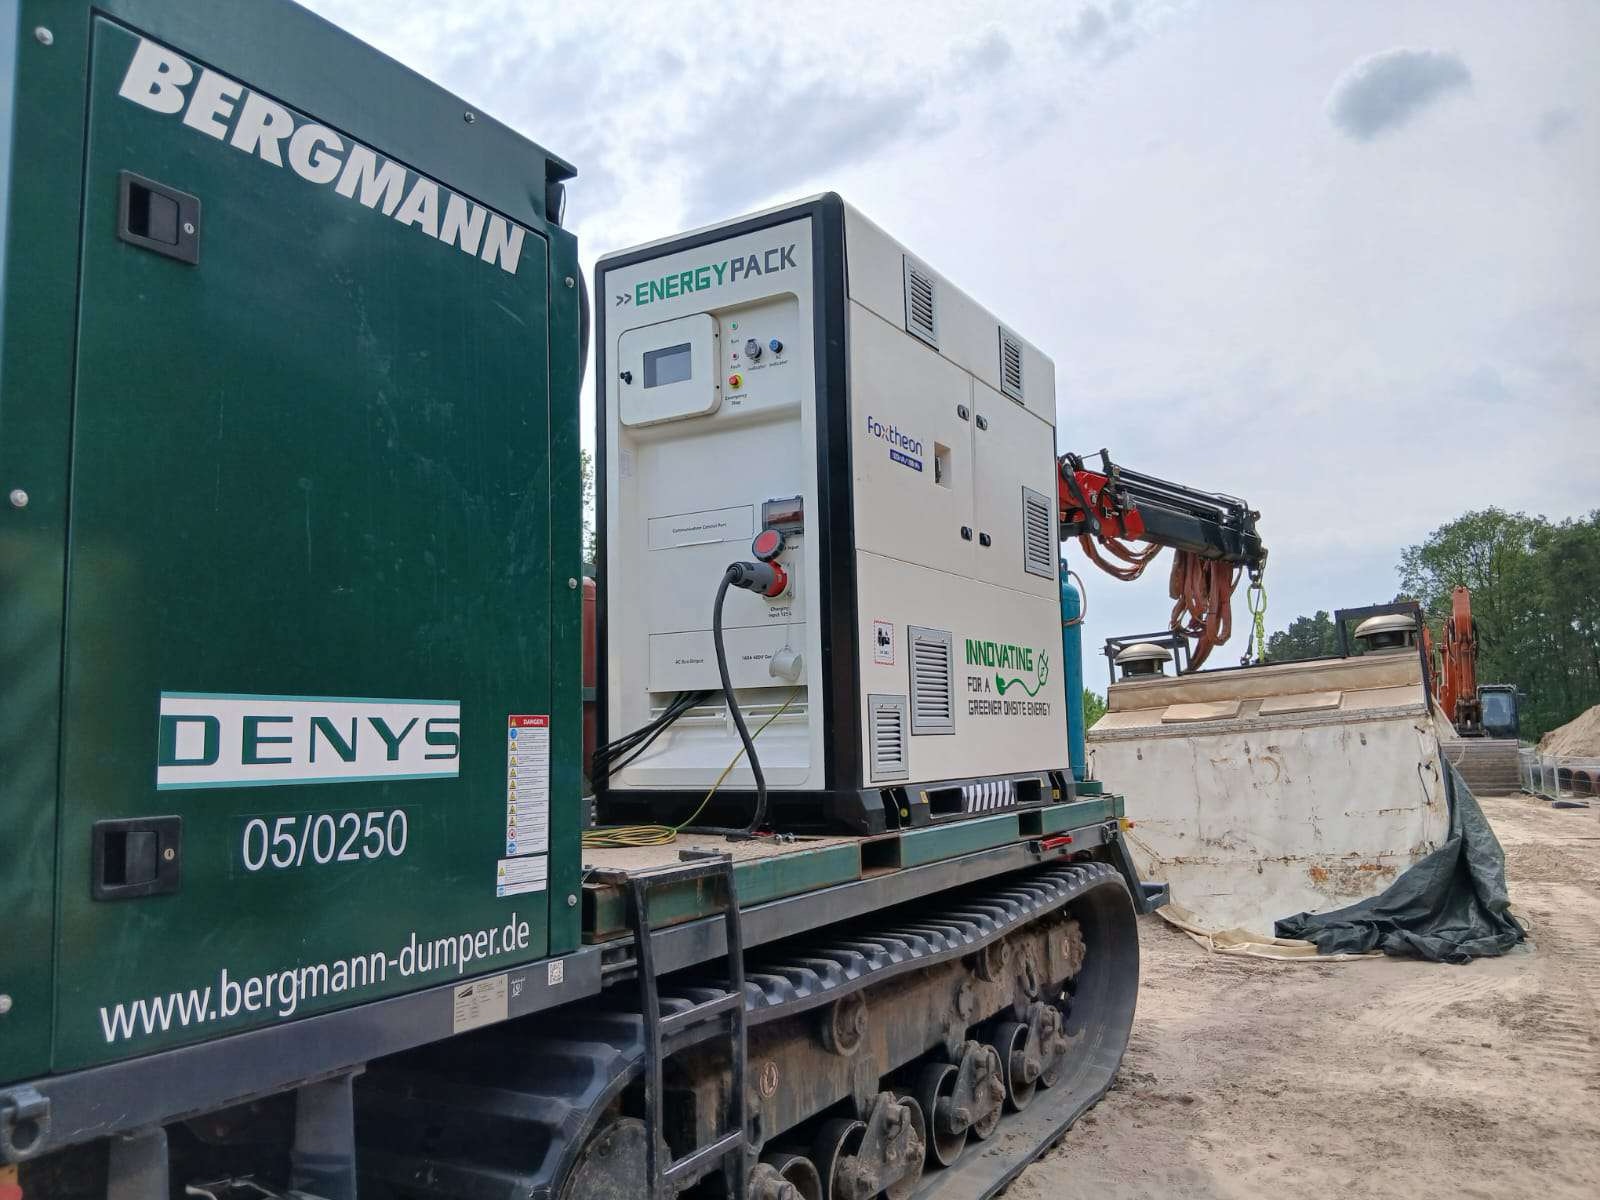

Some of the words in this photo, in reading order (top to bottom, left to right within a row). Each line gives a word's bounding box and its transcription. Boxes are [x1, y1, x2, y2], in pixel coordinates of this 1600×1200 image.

[118, 38, 525, 275] BERGMANN
[966, 638, 1033, 672] INNOVATING
[967, 676, 983, 693] FOR
[984, 677, 991, 693] A
[523, 718, 544, 726] DANGER
[968, 699, 1002, 716] GREENER
[1003, 700, 1027, 716] ONSITE
[1027, 702, 1051, 716] ENERGY
[158, 714, 460, 766] DENYS
[242, 809, 408, 871] 05/0250
[100, 912, 530, 1042] www.bergmann-dumper.de
